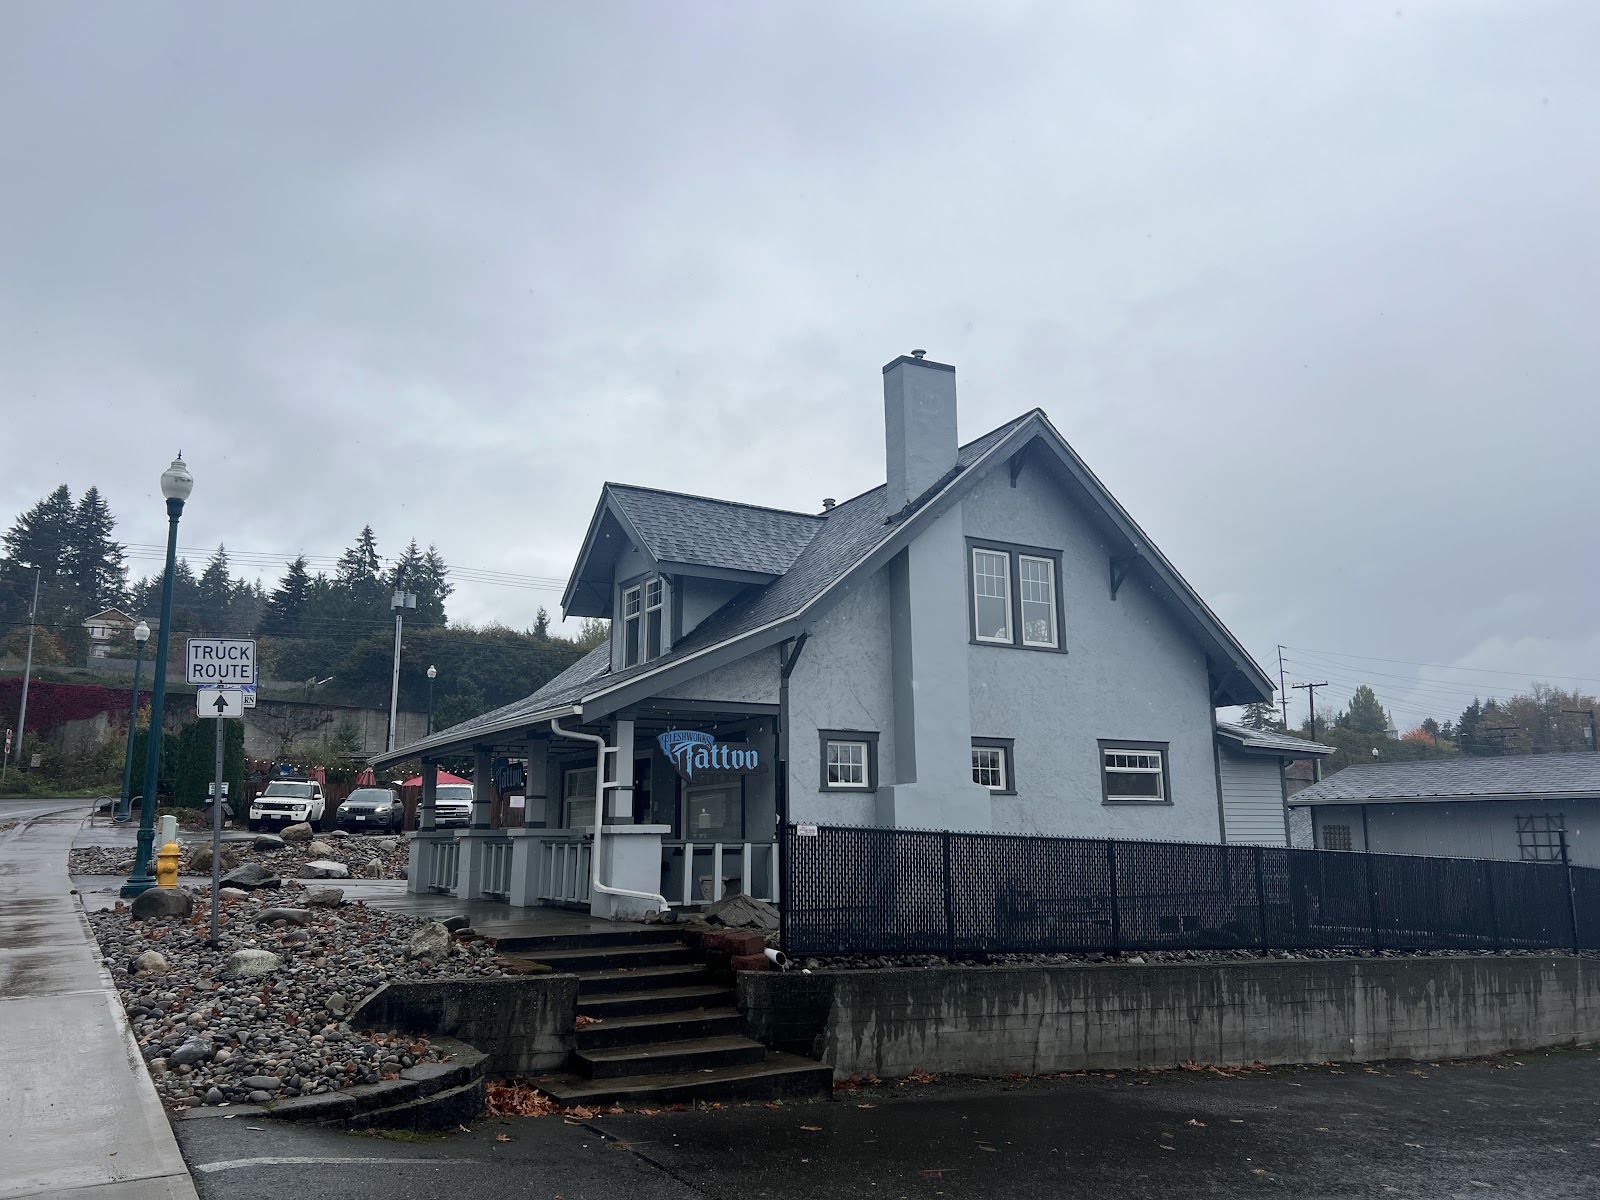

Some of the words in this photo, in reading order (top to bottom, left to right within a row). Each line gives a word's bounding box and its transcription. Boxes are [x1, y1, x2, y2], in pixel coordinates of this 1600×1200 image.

[192, 645, 250, 660] TRUCK
[193, 664, 250, 678] ROUTE
[671, 741, 758, 780] Tattoo
